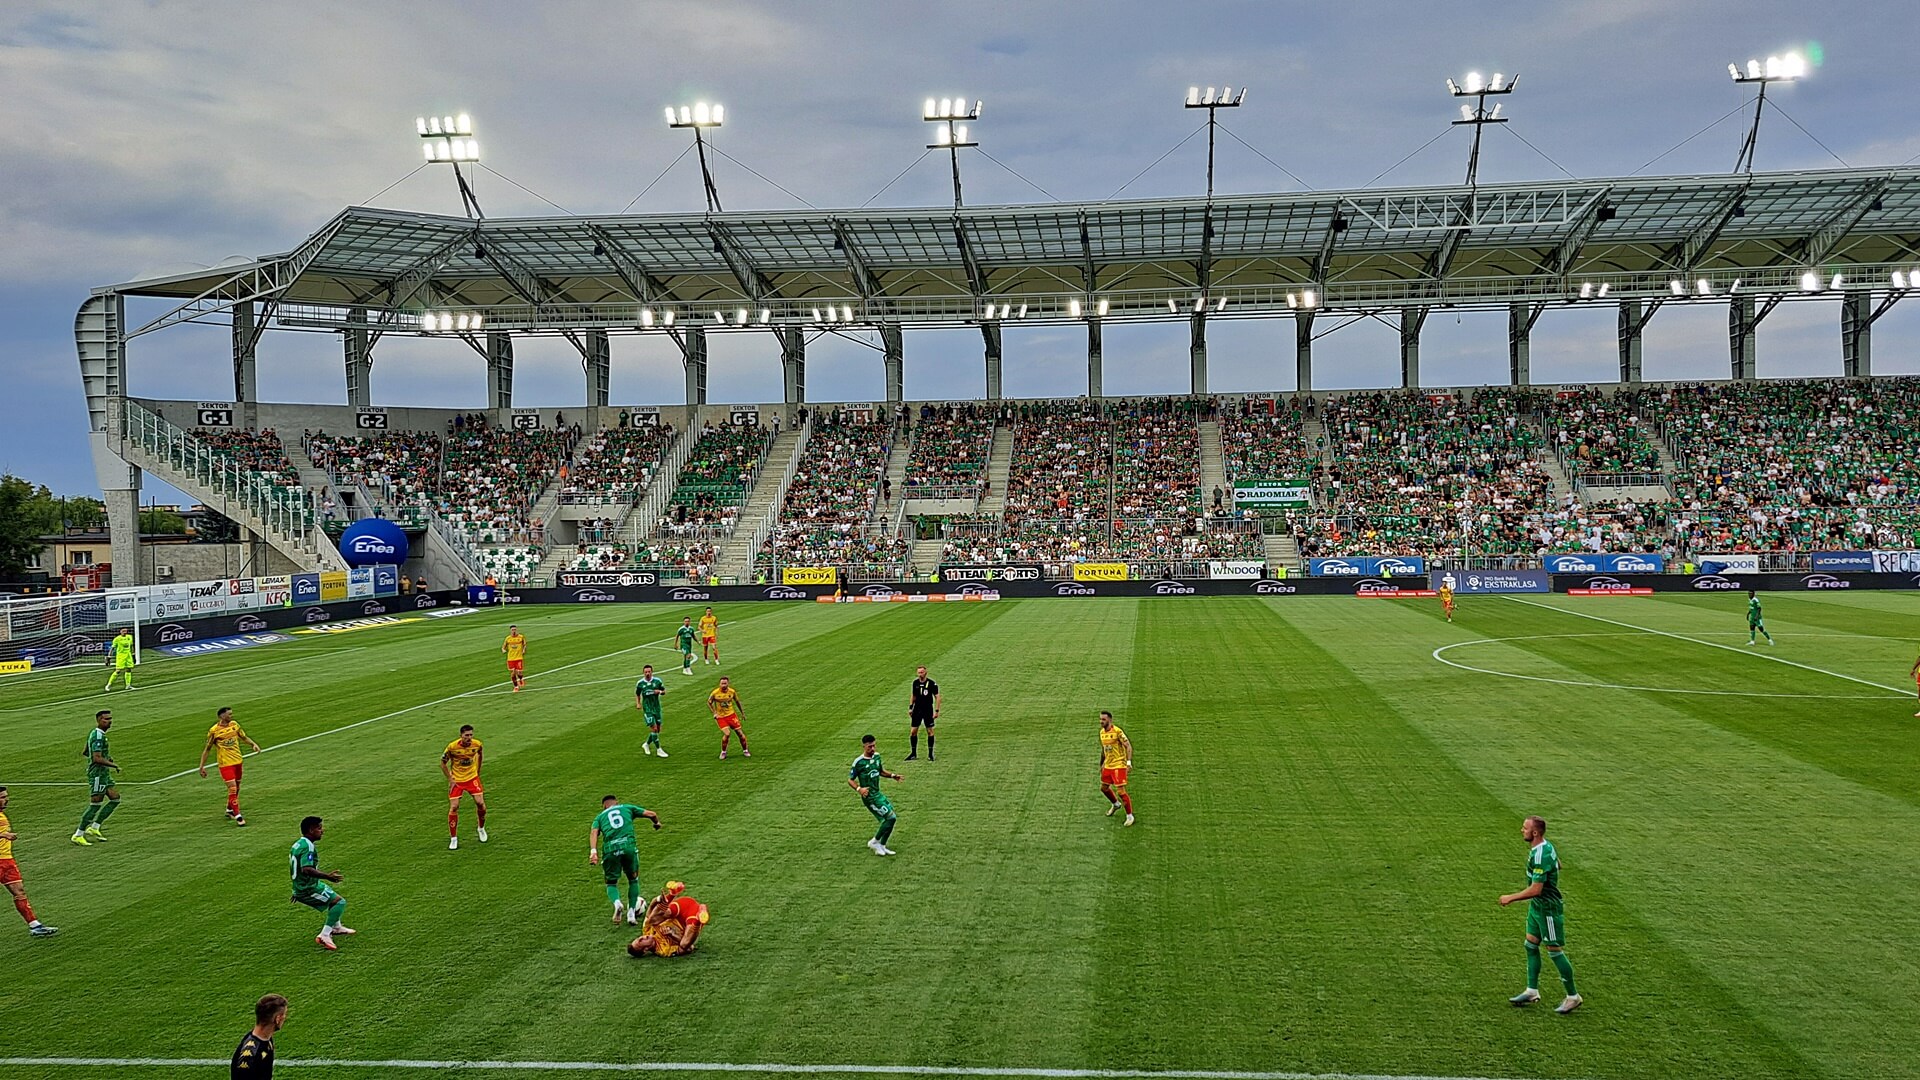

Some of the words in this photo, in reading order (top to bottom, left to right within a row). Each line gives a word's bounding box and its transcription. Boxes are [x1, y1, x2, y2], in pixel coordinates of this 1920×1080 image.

[201, 411, 229, 425] G-1
[359, 415, 386, 428] G-2
[514, 416, 538, 429] G-3
[634, 413, 658, 427] G-4
[733, 413, 756, 425] G-5
[354, 541, 395, 554] Enea
[1323, 564, 1359, 574] Enea
[1558, 562, 1596, 572] Enea
[1617, 561, 1655, 571] Enea
[323, 581, 345, 589] FORTUNA
[379, 577, 395, 586] Enea
[1484, 581, 1537, 589] EKSTRAKLASA
[1590, 581, 1631, 590] Enea
[1699, 580, 1741, 589] Enea
[1807, 580, 1850, 588] Enea
[190, 586, 218, 598] TEXAR
[298, 585, 317, 595] Enea
[866, 588, 902, 596] Enea
[963, 587, 999, 595] Enea
[1058, 587, 1095, 595] Enea
[1156, 585, 1195, 594] Enea
[1257, 585, 1296, 593] Enea
[1359, 584, 1399, 592] Enea
[266, 591, 287, 605] KFC
[579, 593, 615, 602] Enea
[673, 591, 710, 600] Enea
[769, 590, 807, 599] Enea
[167, 604, 185, 612] TEKOM
[417, 599, 437, 608] Enea
[364, 605, 386, 615] Enea
[306, 612, 331, 622] Enea
[238, 620, 268, 632] Enea
[160, 629, 194, 643] Enea
[607, 809, 624, 829] 6
